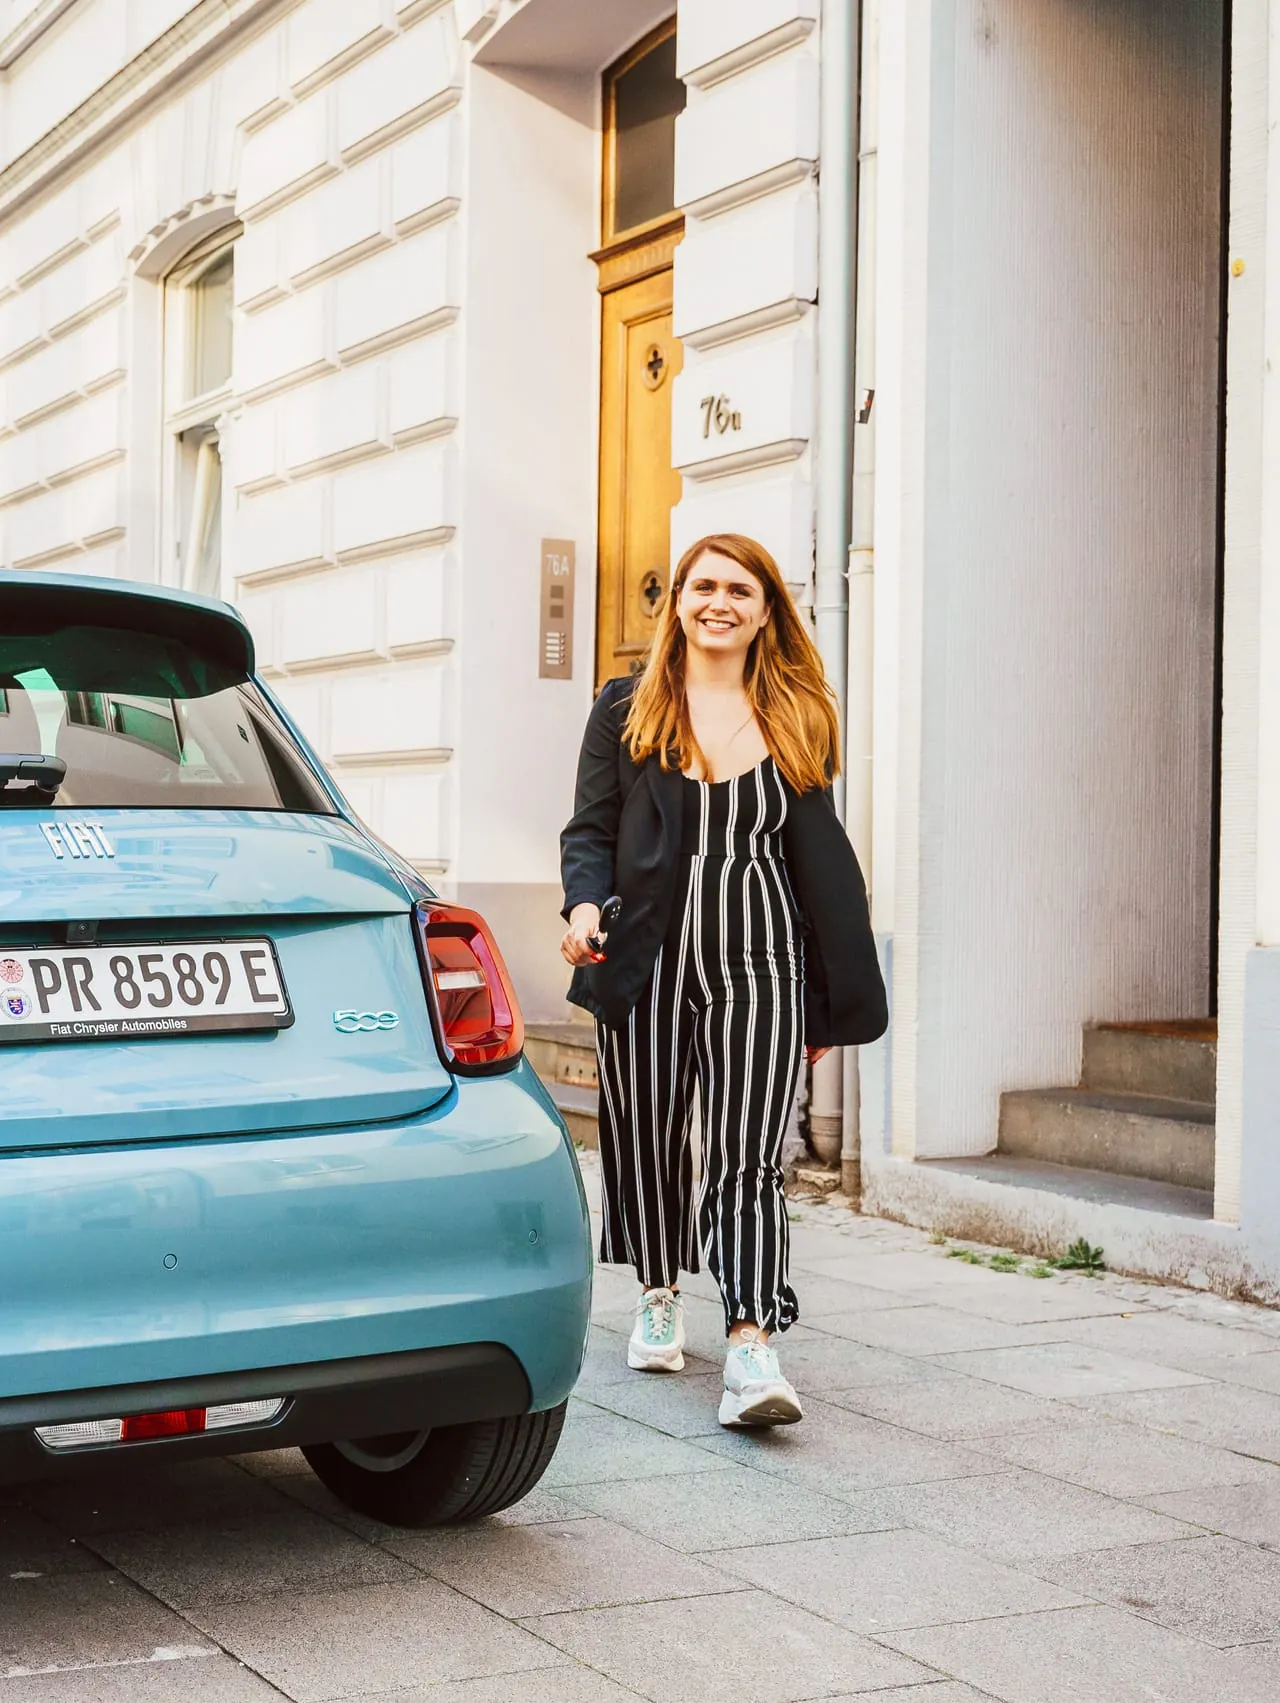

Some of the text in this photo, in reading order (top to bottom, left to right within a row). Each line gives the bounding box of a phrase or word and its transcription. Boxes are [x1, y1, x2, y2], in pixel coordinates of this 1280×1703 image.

[545, 553, 569, 576] 76A
[38, 822, 115, 859] FIAT
[28, 957, 102, 1013] PR
[109, 951, 231, 1009] 8589
[240, 950, 279, 1002] E
[50, 1018, 188, 1036] Fiat Chrysler Automobiles
